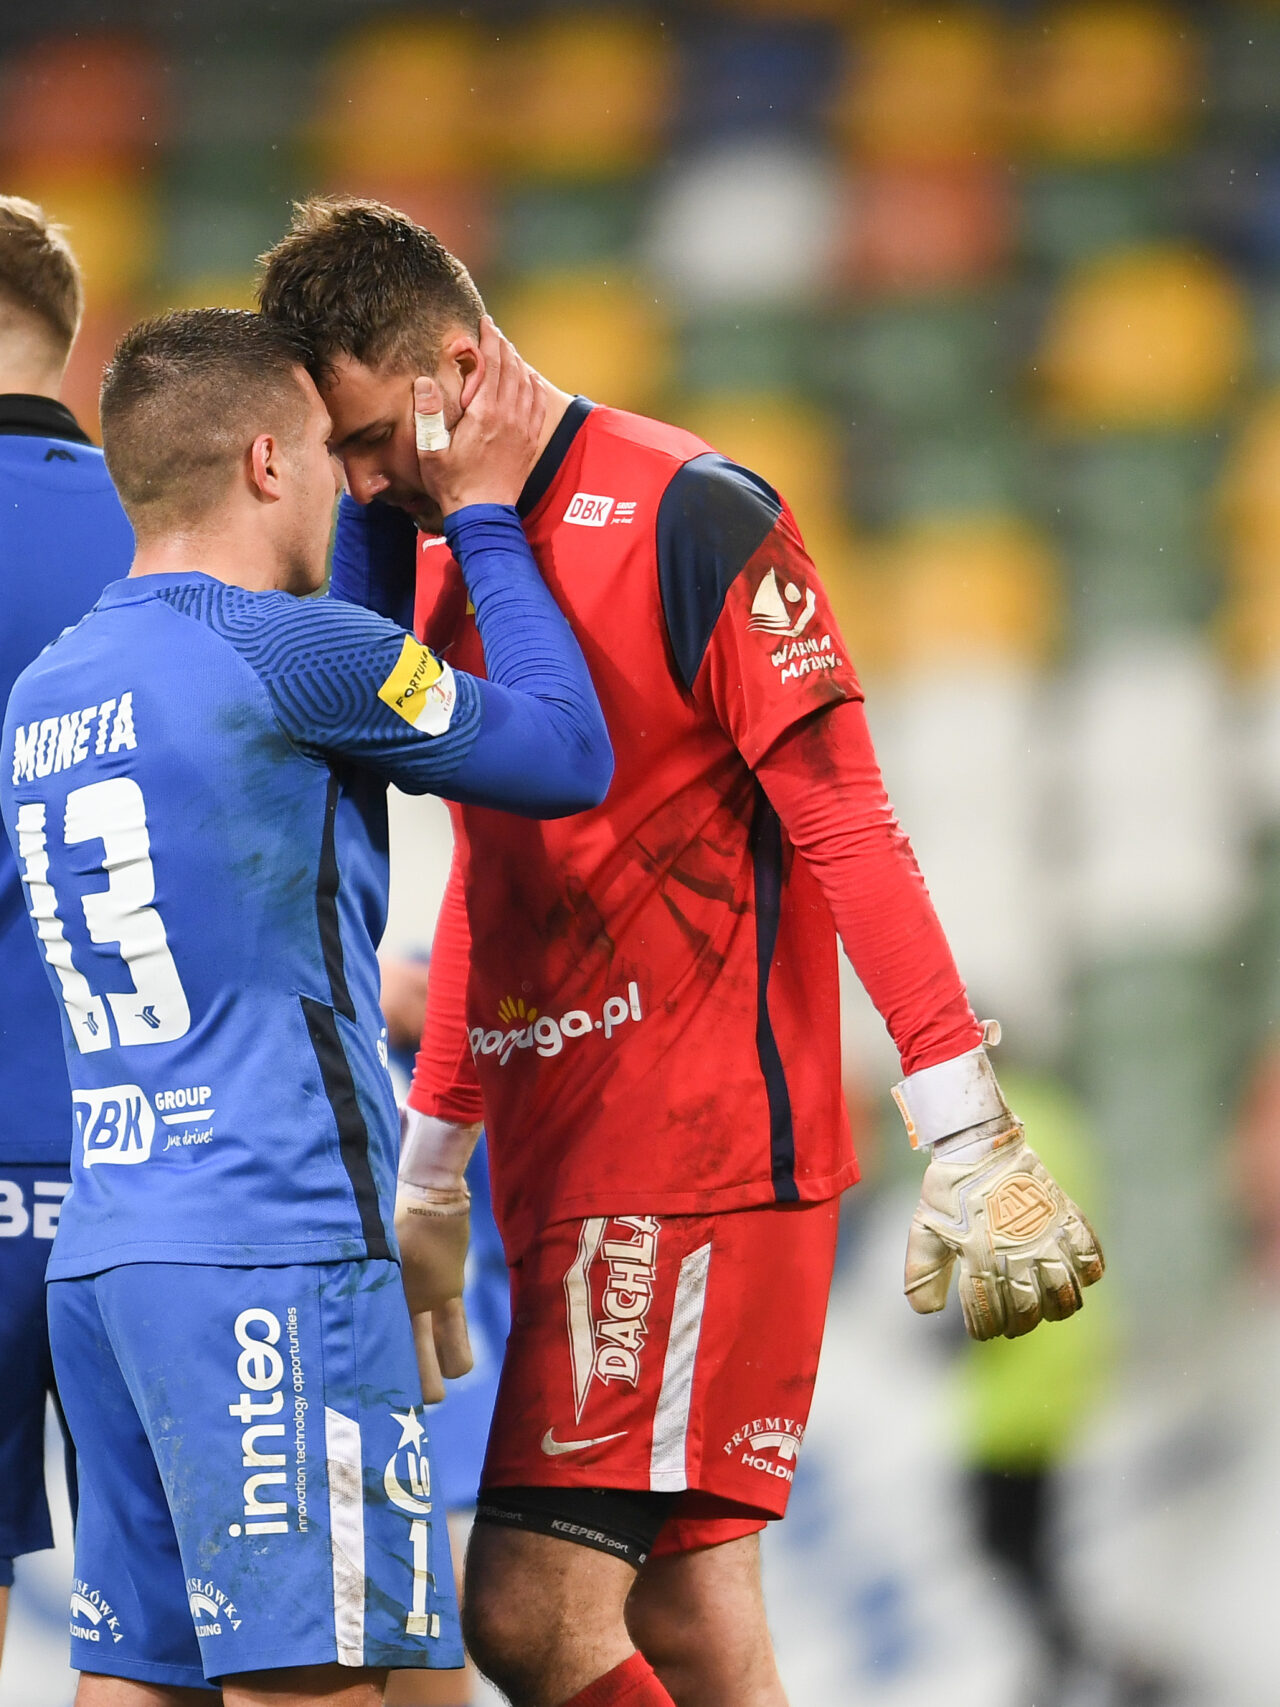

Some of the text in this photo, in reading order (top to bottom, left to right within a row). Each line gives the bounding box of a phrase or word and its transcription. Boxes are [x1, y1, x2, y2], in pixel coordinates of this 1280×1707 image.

[568, 498, 608, 522] DBK
[395, 650, 429, 709] FORTUNA
[12, 691, 138, 786] MONETA
[15, 777, 191, 1054] 13
[155, 1086, 212, 1111] GROUP
[285, 1307, 309, 1533] innovation technology opportunities
[723, 1417, 805, 1455] PRZEMYS
[551, 1518, 629, 1554] KEEPERsport
